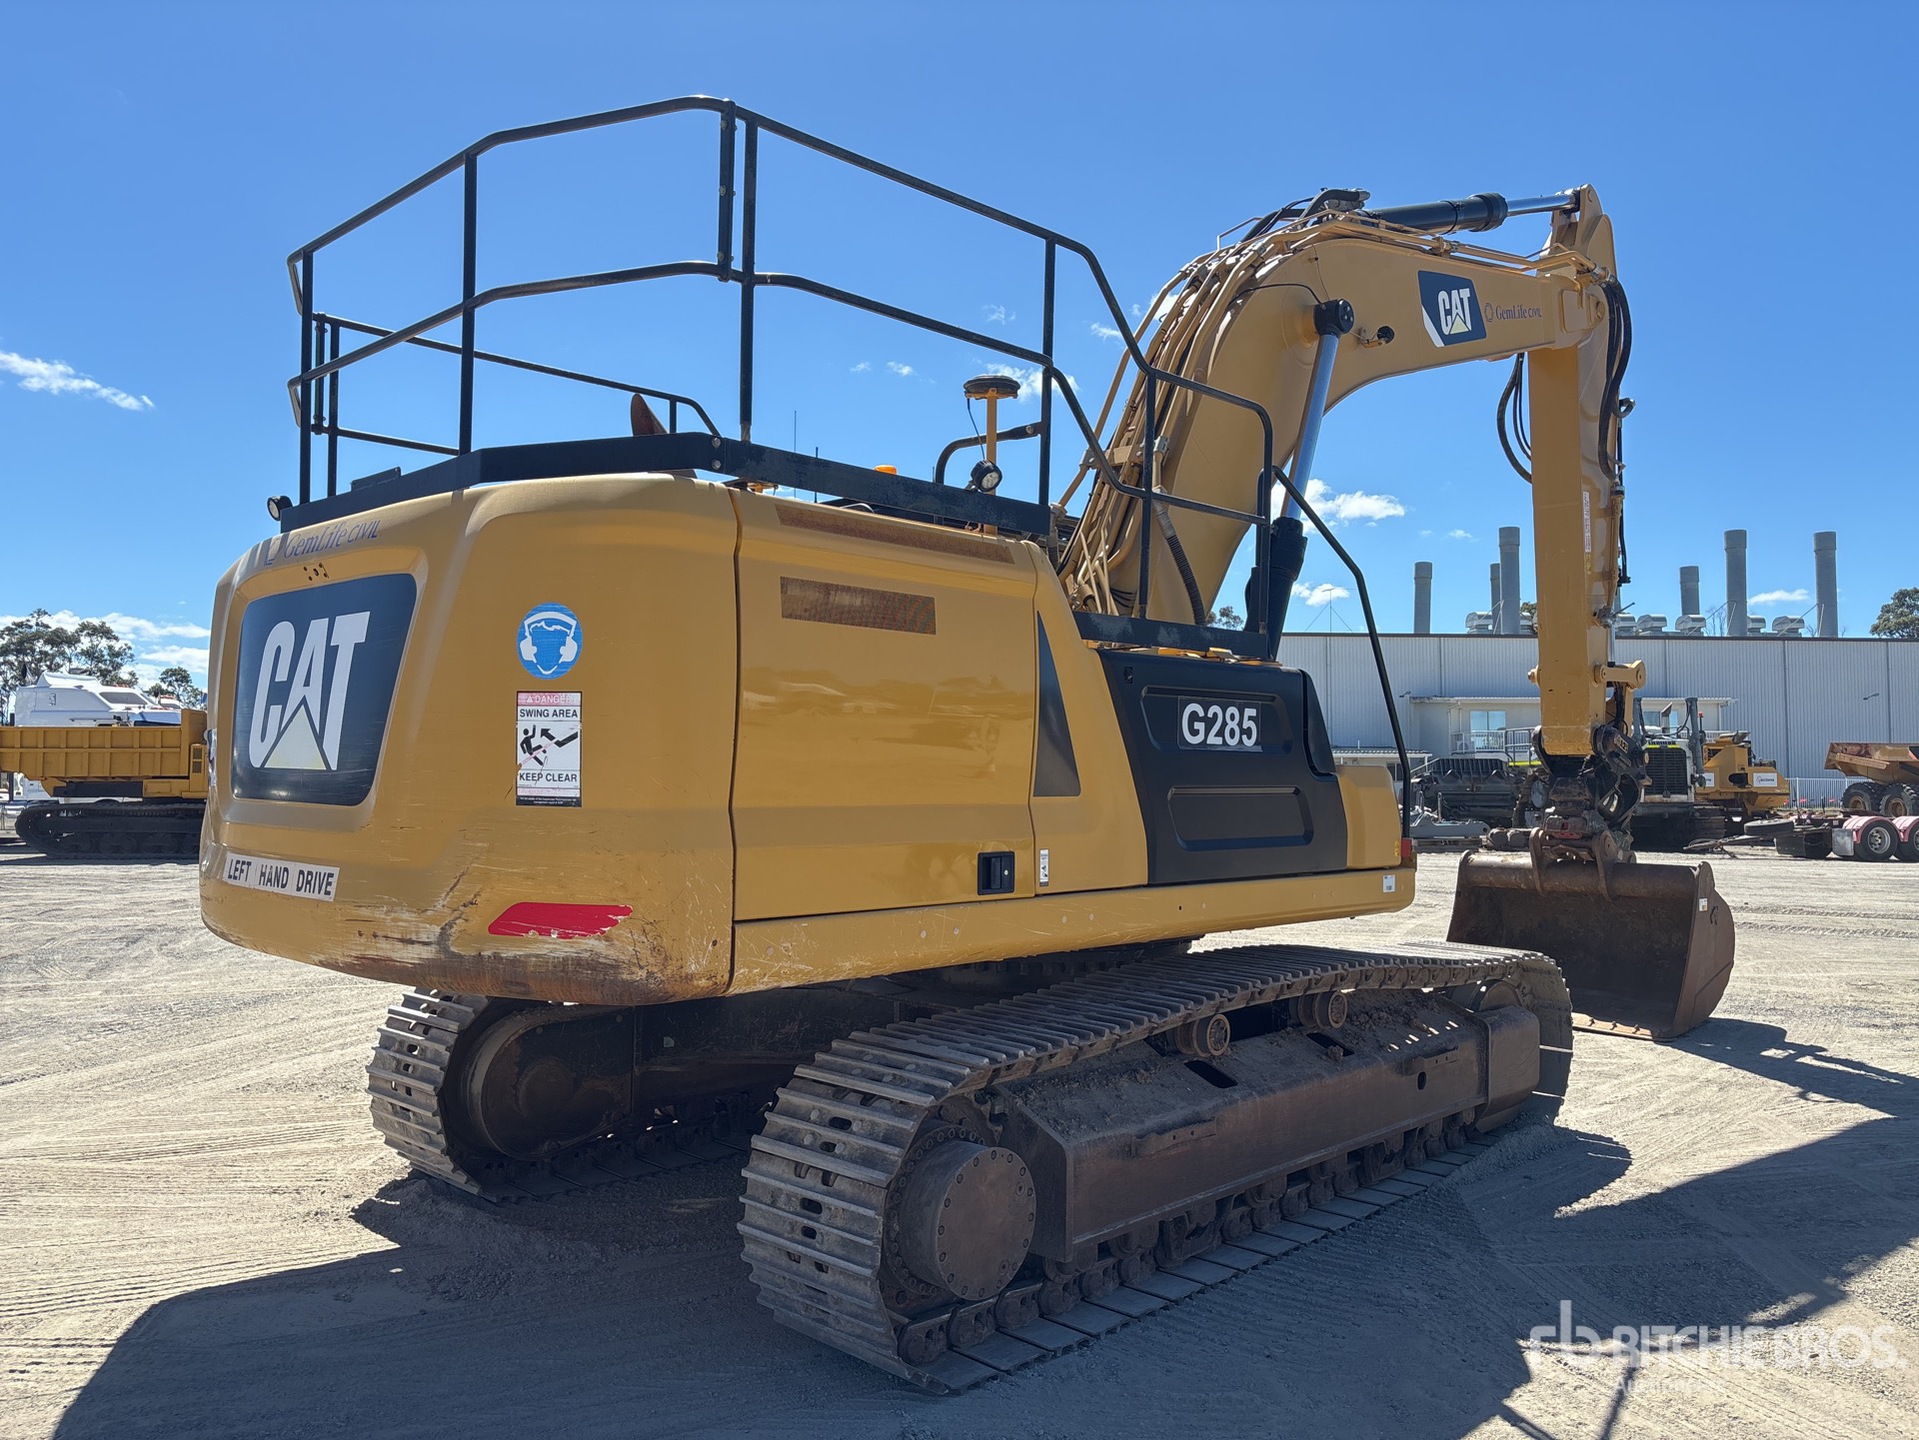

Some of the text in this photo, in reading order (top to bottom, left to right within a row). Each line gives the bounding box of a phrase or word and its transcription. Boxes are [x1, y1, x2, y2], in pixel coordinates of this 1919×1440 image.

[1438, 288, 1472, 335] CAT
[1495, 304, 1527, 320] GemLife
[284, 519, 381, 558] GemLife CIVIL
[249, 611, 370, 770] CAT
[519, 708, 578, 718] SWING AREA
[1182, 703, 1257, 747] G285
[519, 772, 578, 782] KEEP CLEAR
[227, 859, 335, 896] LEFT HAND DRIVE
